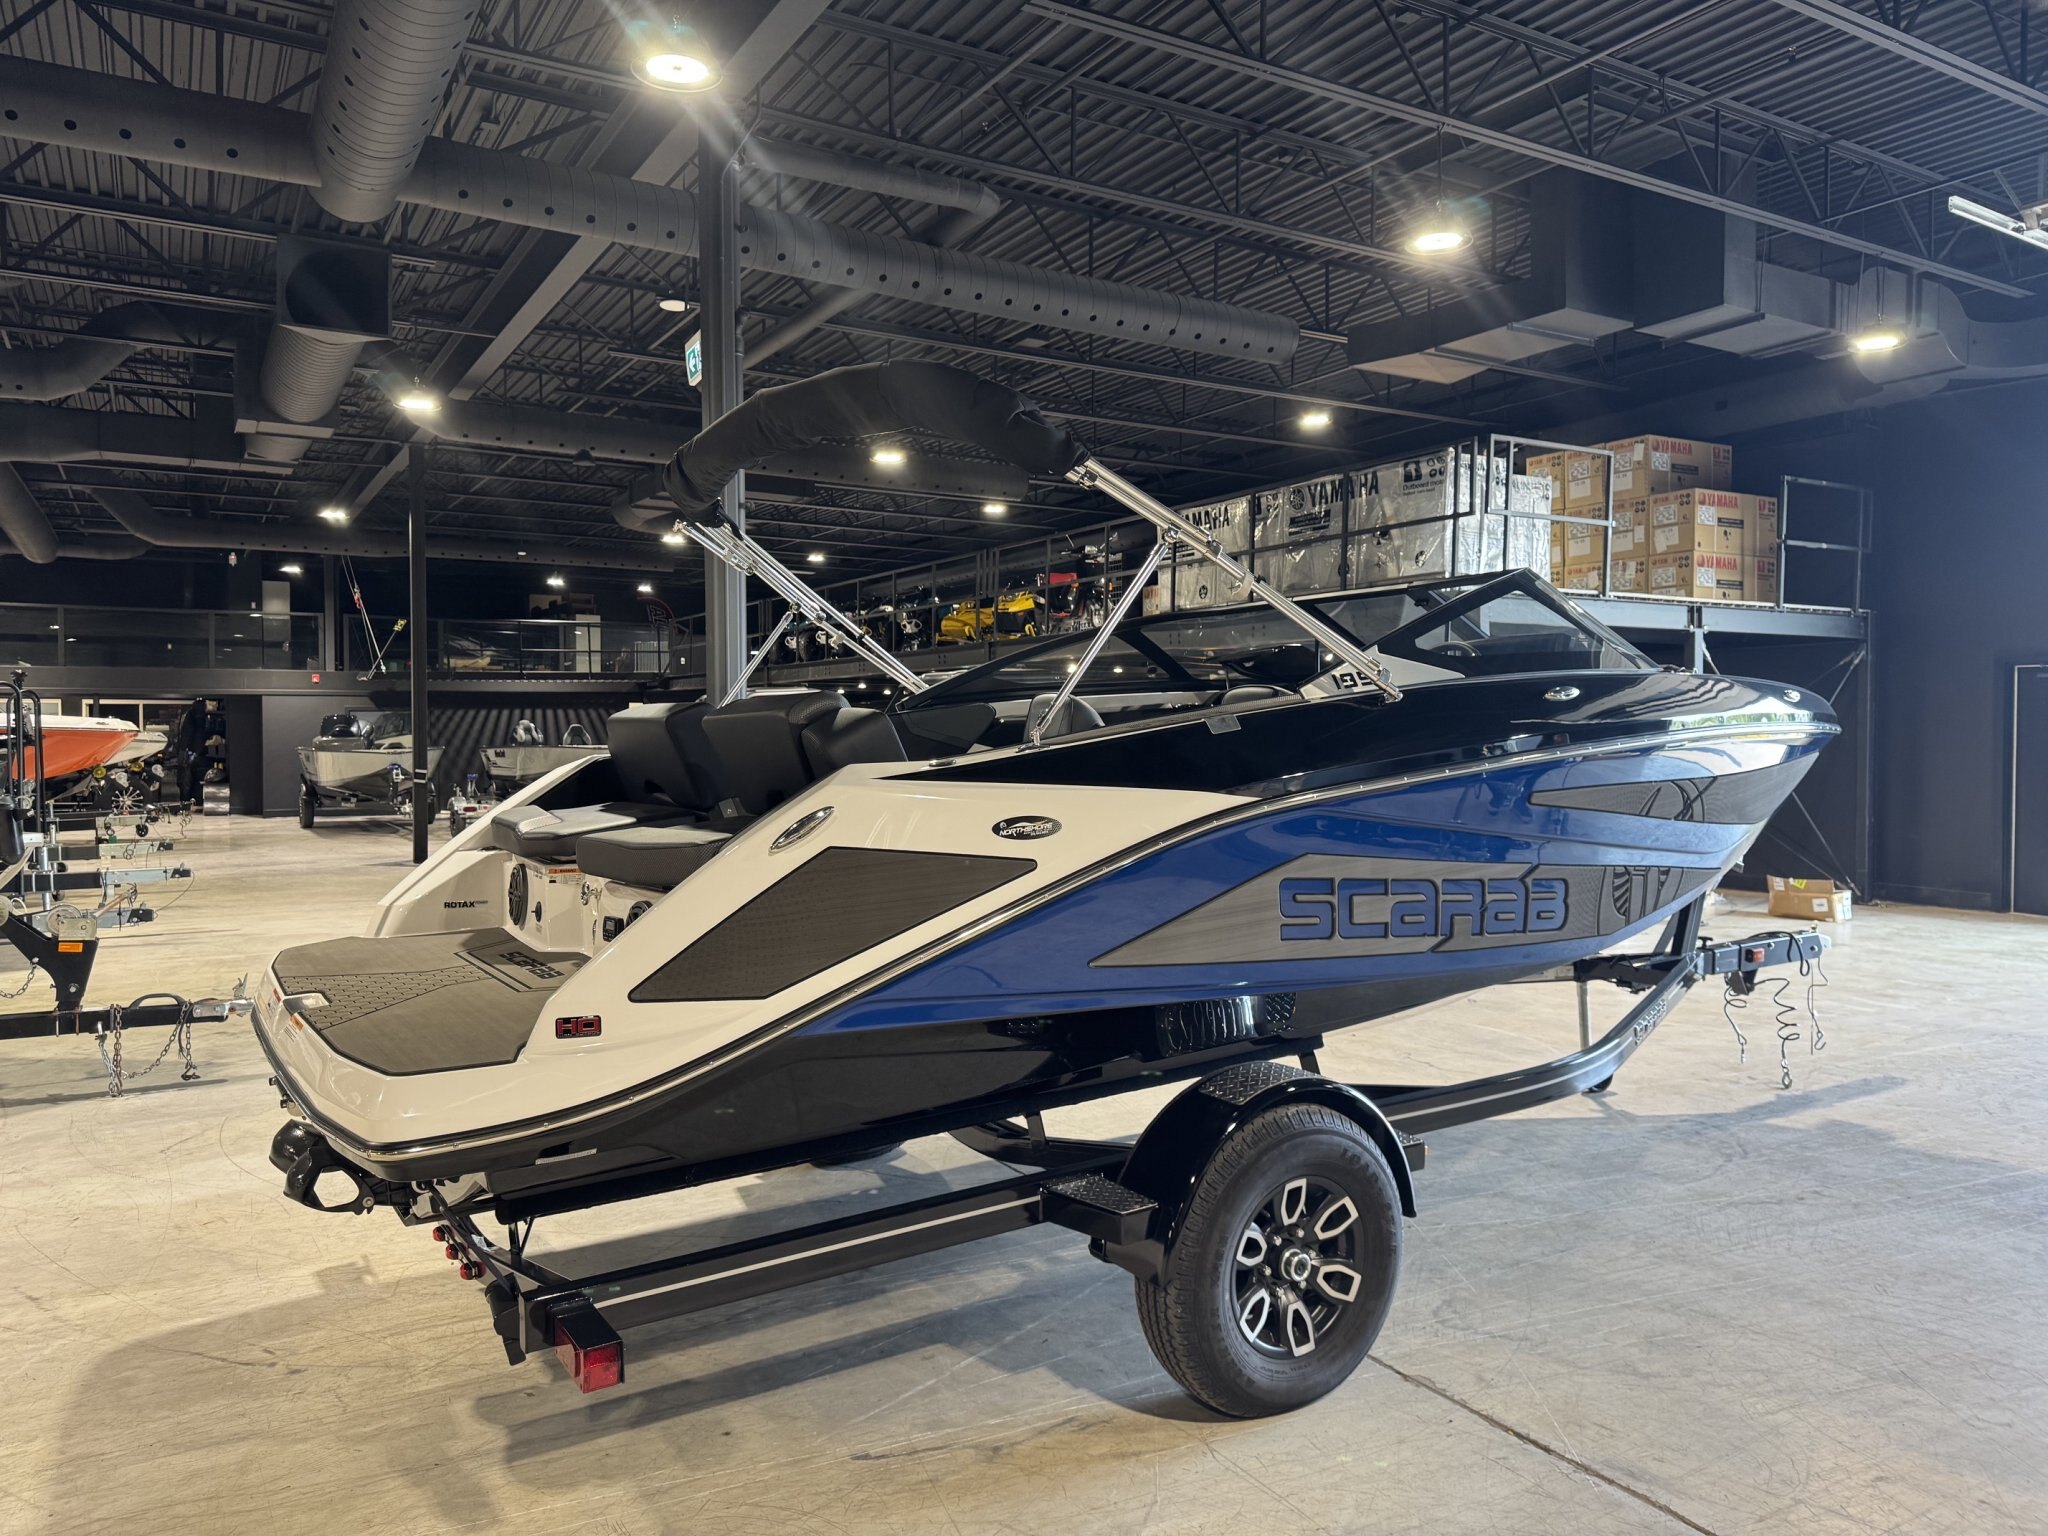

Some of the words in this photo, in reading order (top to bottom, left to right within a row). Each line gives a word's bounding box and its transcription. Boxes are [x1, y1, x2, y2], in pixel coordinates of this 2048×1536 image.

[1660, 440, 1692, 456] YAMAHA
[1706, 492, 1738, 509] YAMAHA
[1705, 555, 1738, 571] YAMAHA
[444, 900, 475, 909] ROTAX
[556, 1016, 600, 1034] HO
